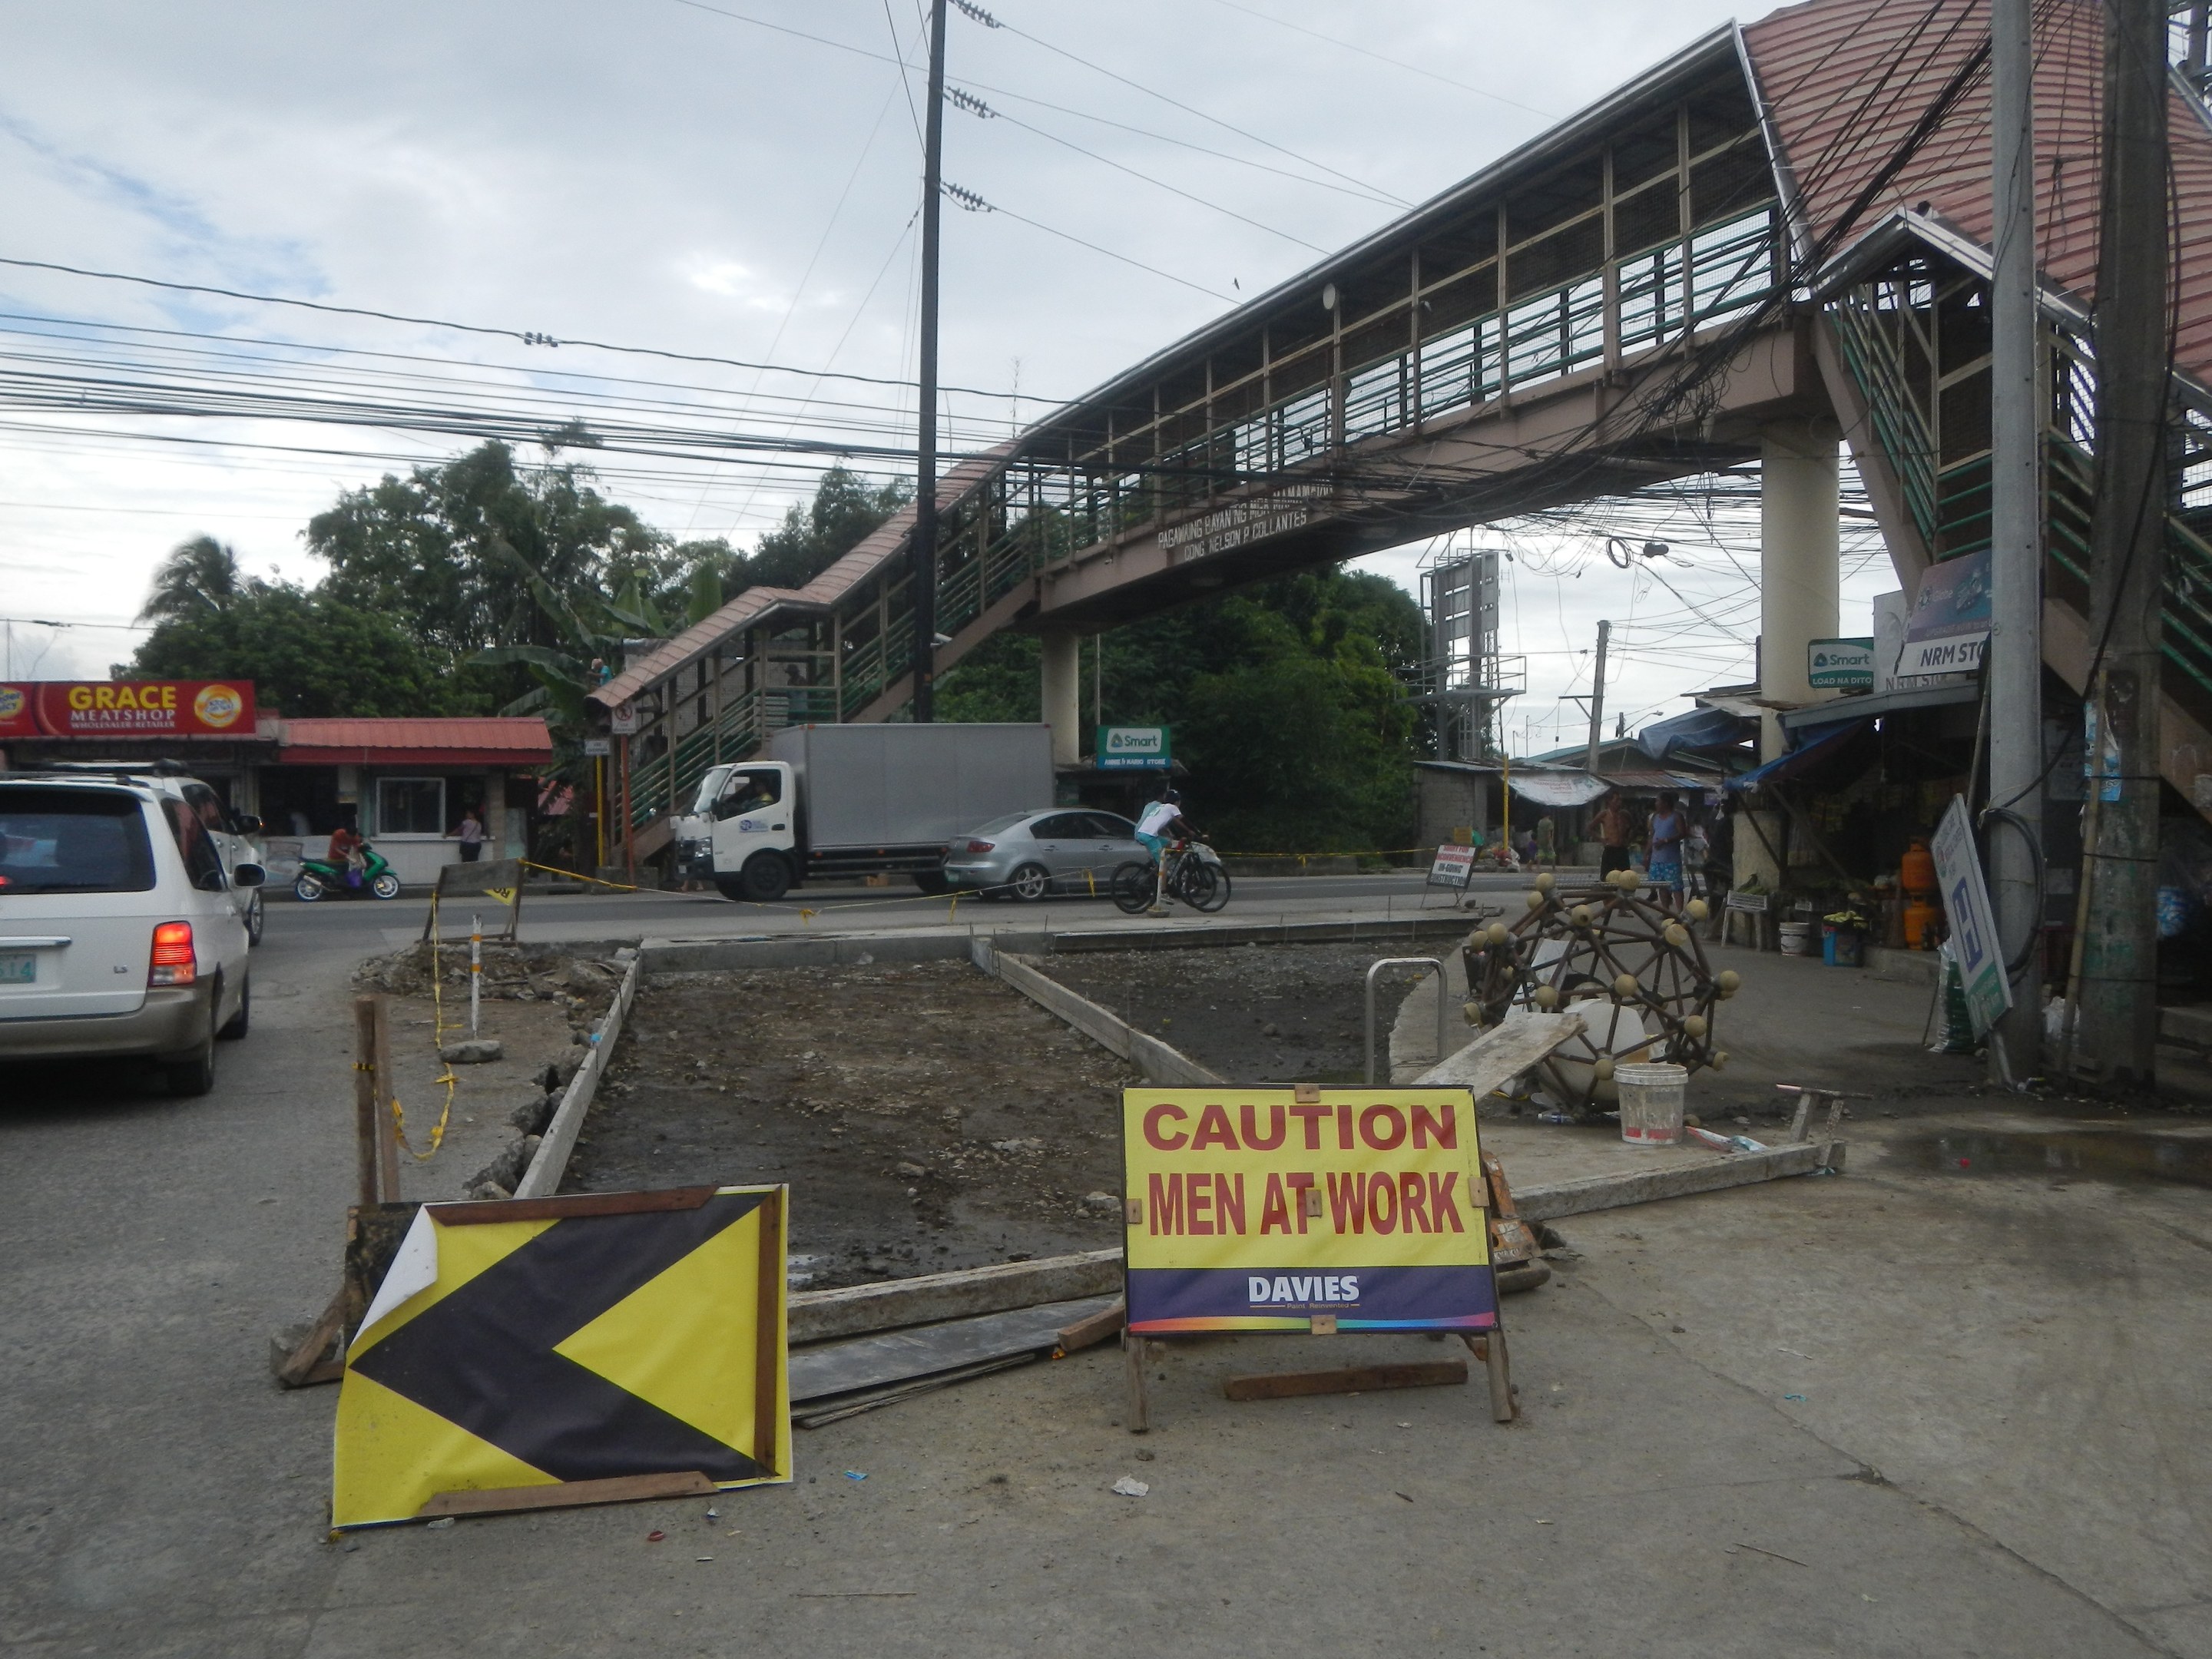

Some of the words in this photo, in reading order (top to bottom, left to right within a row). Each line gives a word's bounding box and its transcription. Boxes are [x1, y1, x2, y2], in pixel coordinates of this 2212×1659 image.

[1205, 509, 1231, 534] BAYAN
[1209, 529, 1240, 554] NELSON
[1253, 508, 1307, 540] COLLANTES
[1830, 653, 1869, 667] Smart
[1920, 642, 1955, 667] NRM
[68, 686, 177, 710] GRACE
[1124, 735, 1157, 747] Smart
[1142, 1103, 1459, 1151] CAUTION
[1148, 1172, 1247, 1236] MEN
[1260, 1171, 1316, 1236] AT
[1326, 1171, 1465, 1235] WORK
[1248, 1275, 1360, 1302] DAVIES
